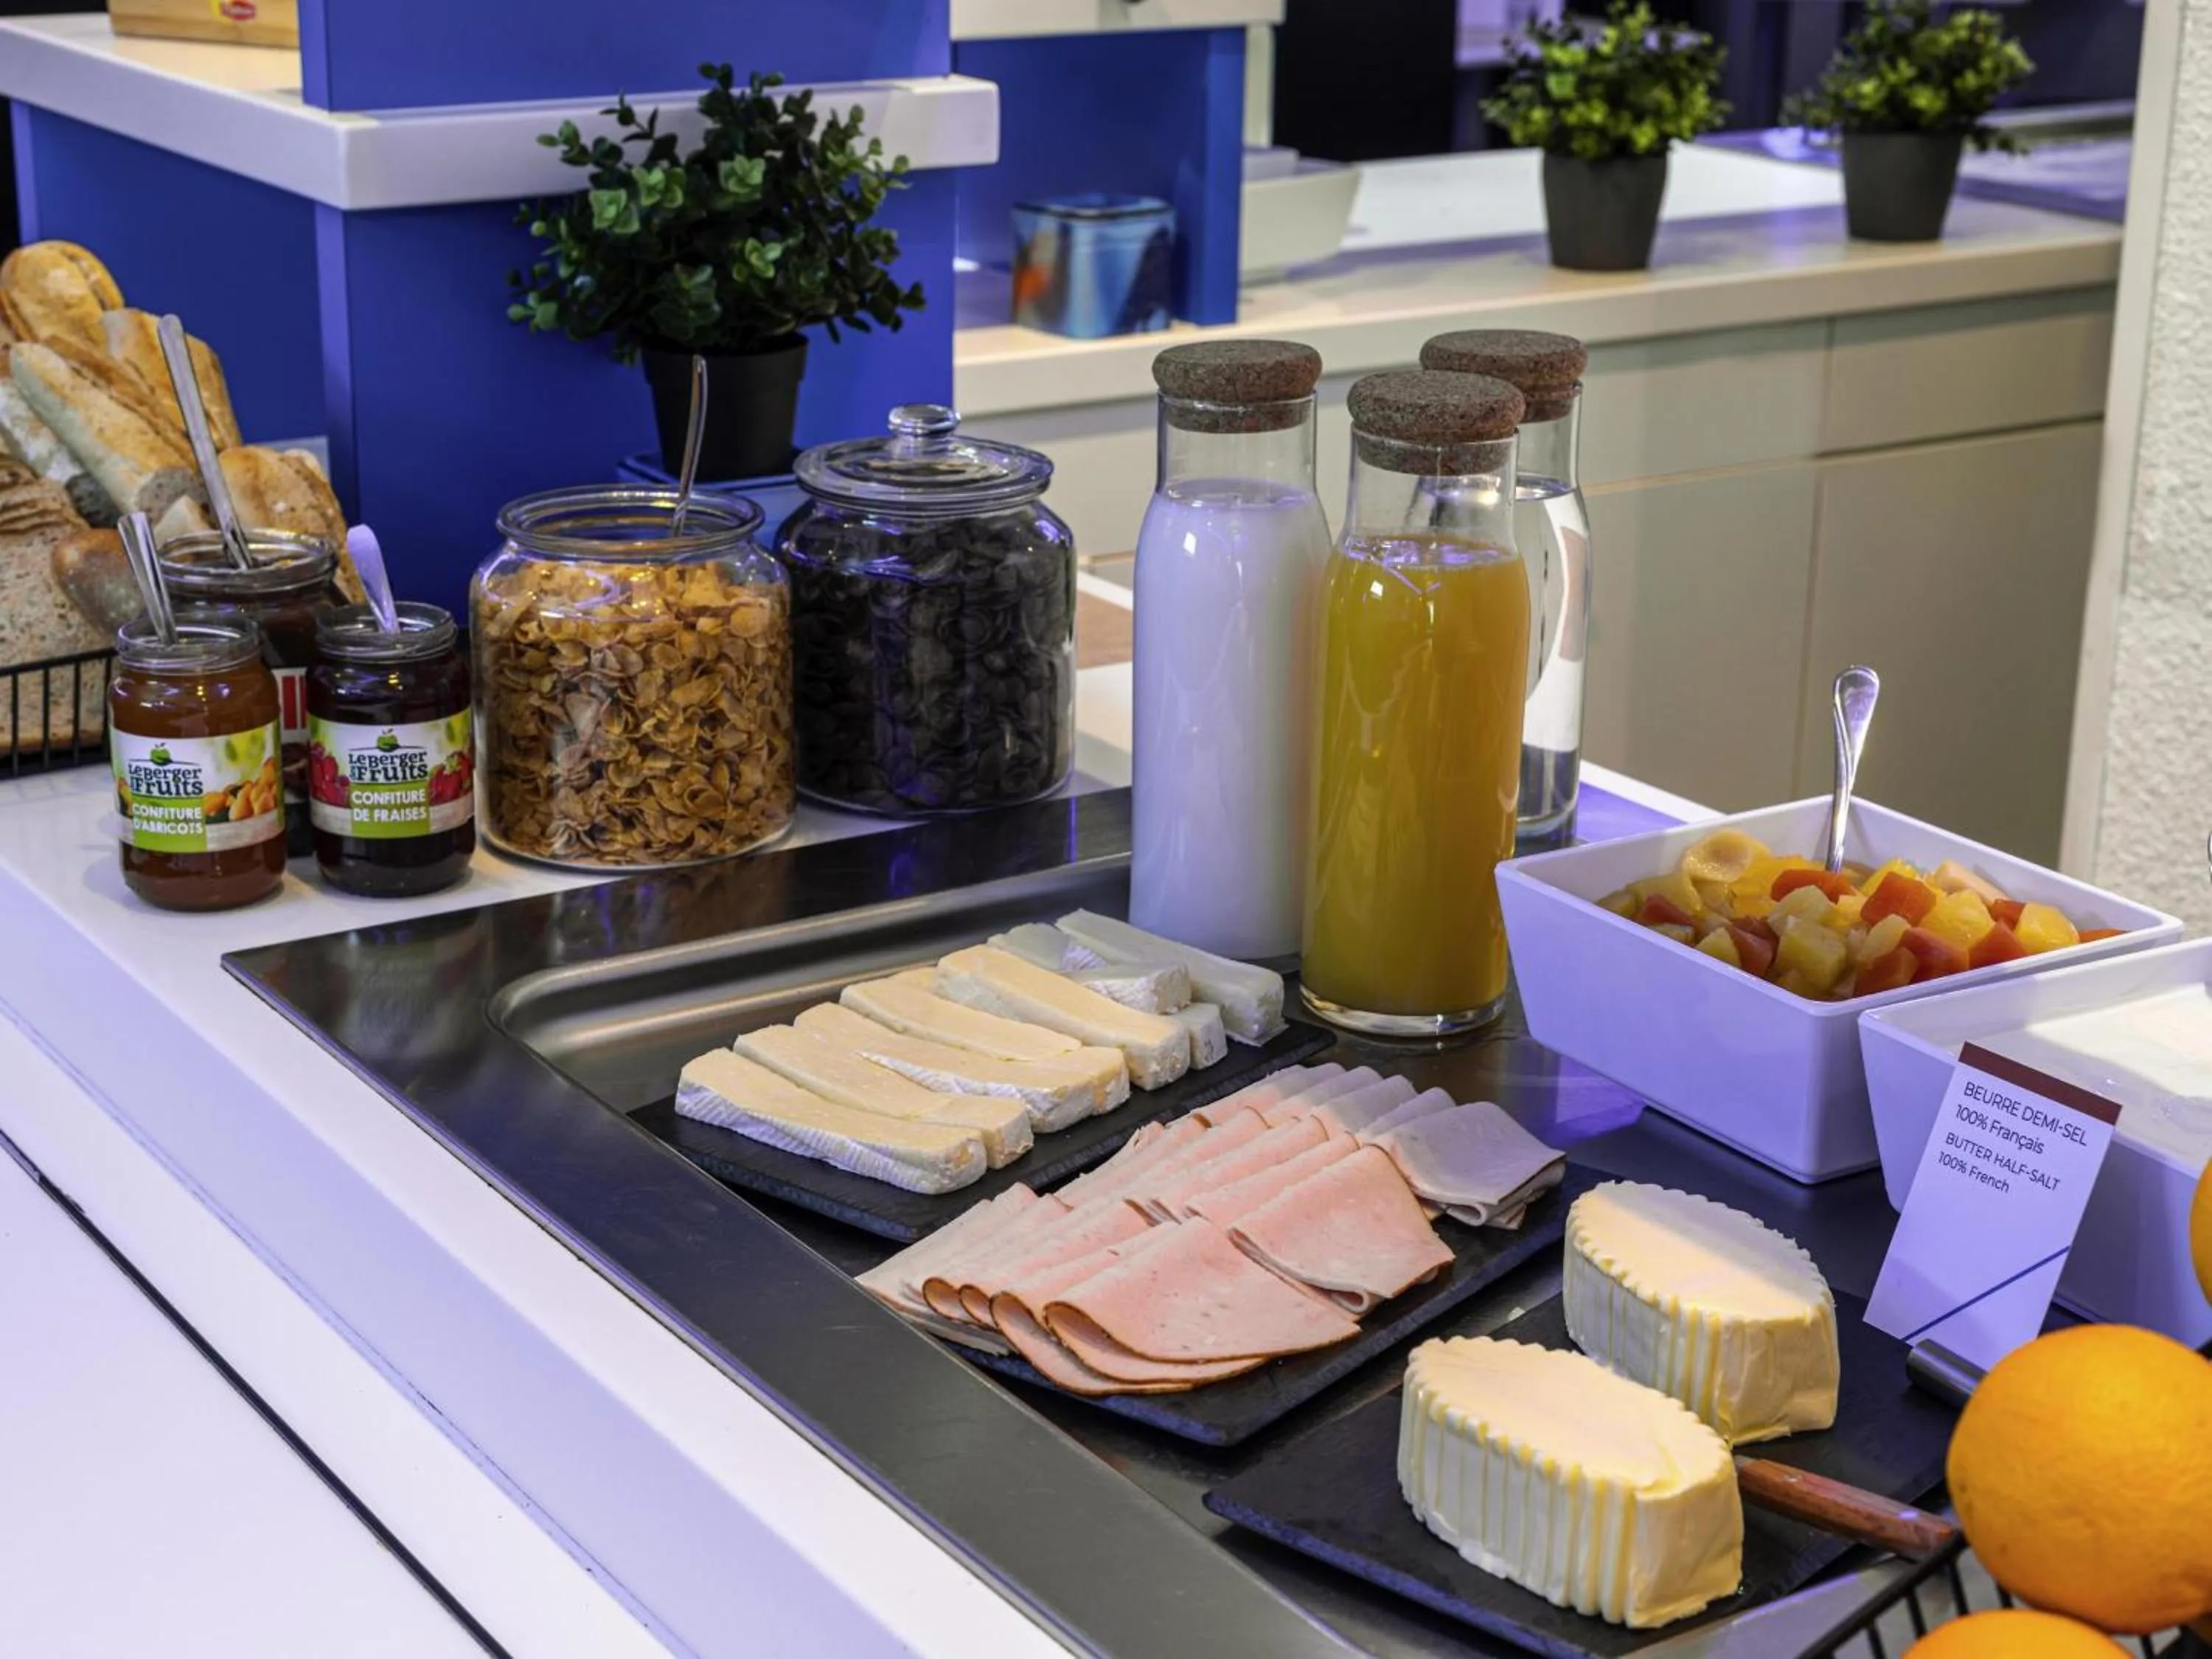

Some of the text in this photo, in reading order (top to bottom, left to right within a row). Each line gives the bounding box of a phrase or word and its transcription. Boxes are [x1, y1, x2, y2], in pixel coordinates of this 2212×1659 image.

[358, 765, 428, 781] Fruits
[135, 777, 203, 796] Fruits
[352, 789, 425, 804] CONFITURE
[133, 803, 201, 821] CONFITURE
[354, 807, 427, 822] DE FRAISES
[133, 817, 204, 835] D'ABRICOTS
[1964, 1081, 2087, 1147] BEURRE DEMI-SEL
[1955, 1105, 2045, 1155] 100% Français
[1946, 1132, 2061, 1192] BUTTER HALF-SALT
[1938, 1151, 2010, 1194] 100% French
